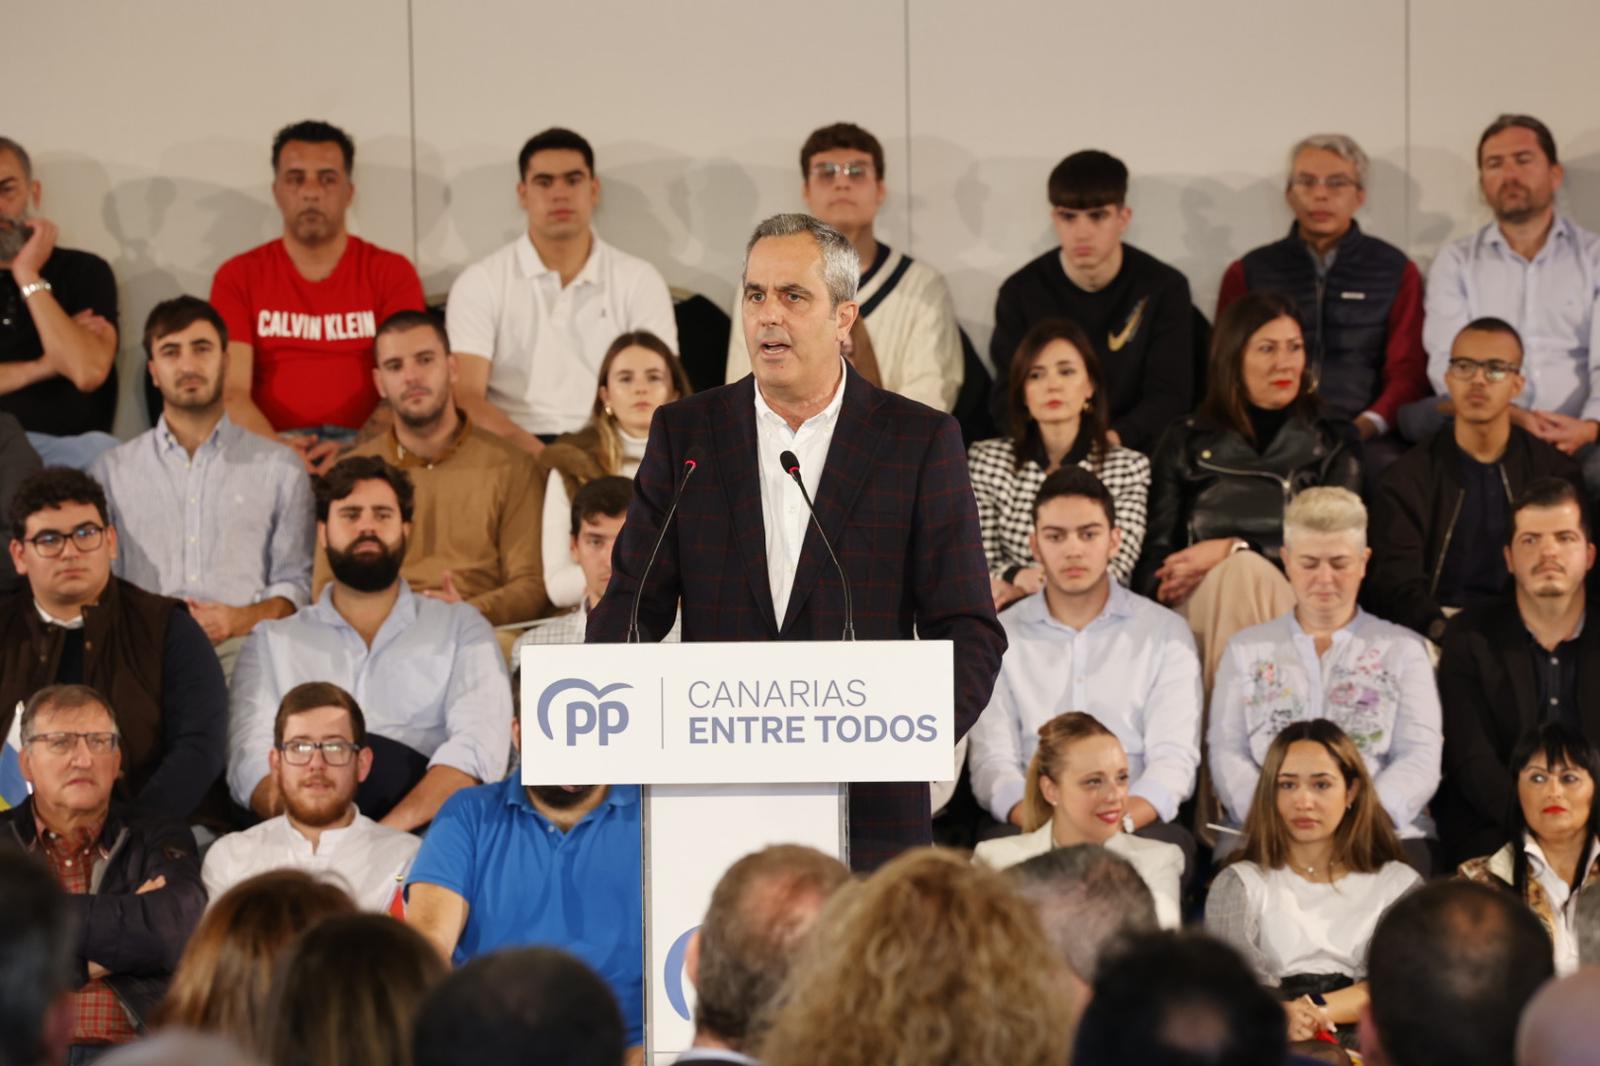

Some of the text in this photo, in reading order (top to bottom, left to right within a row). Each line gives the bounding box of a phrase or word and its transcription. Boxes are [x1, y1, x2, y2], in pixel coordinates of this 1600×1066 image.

[257, 309, 376, 341] CALVIN KLEIN
[688, 679, 867, 708] CANARIAS
[689, 714, 938, 745] ENTRE TODOS
